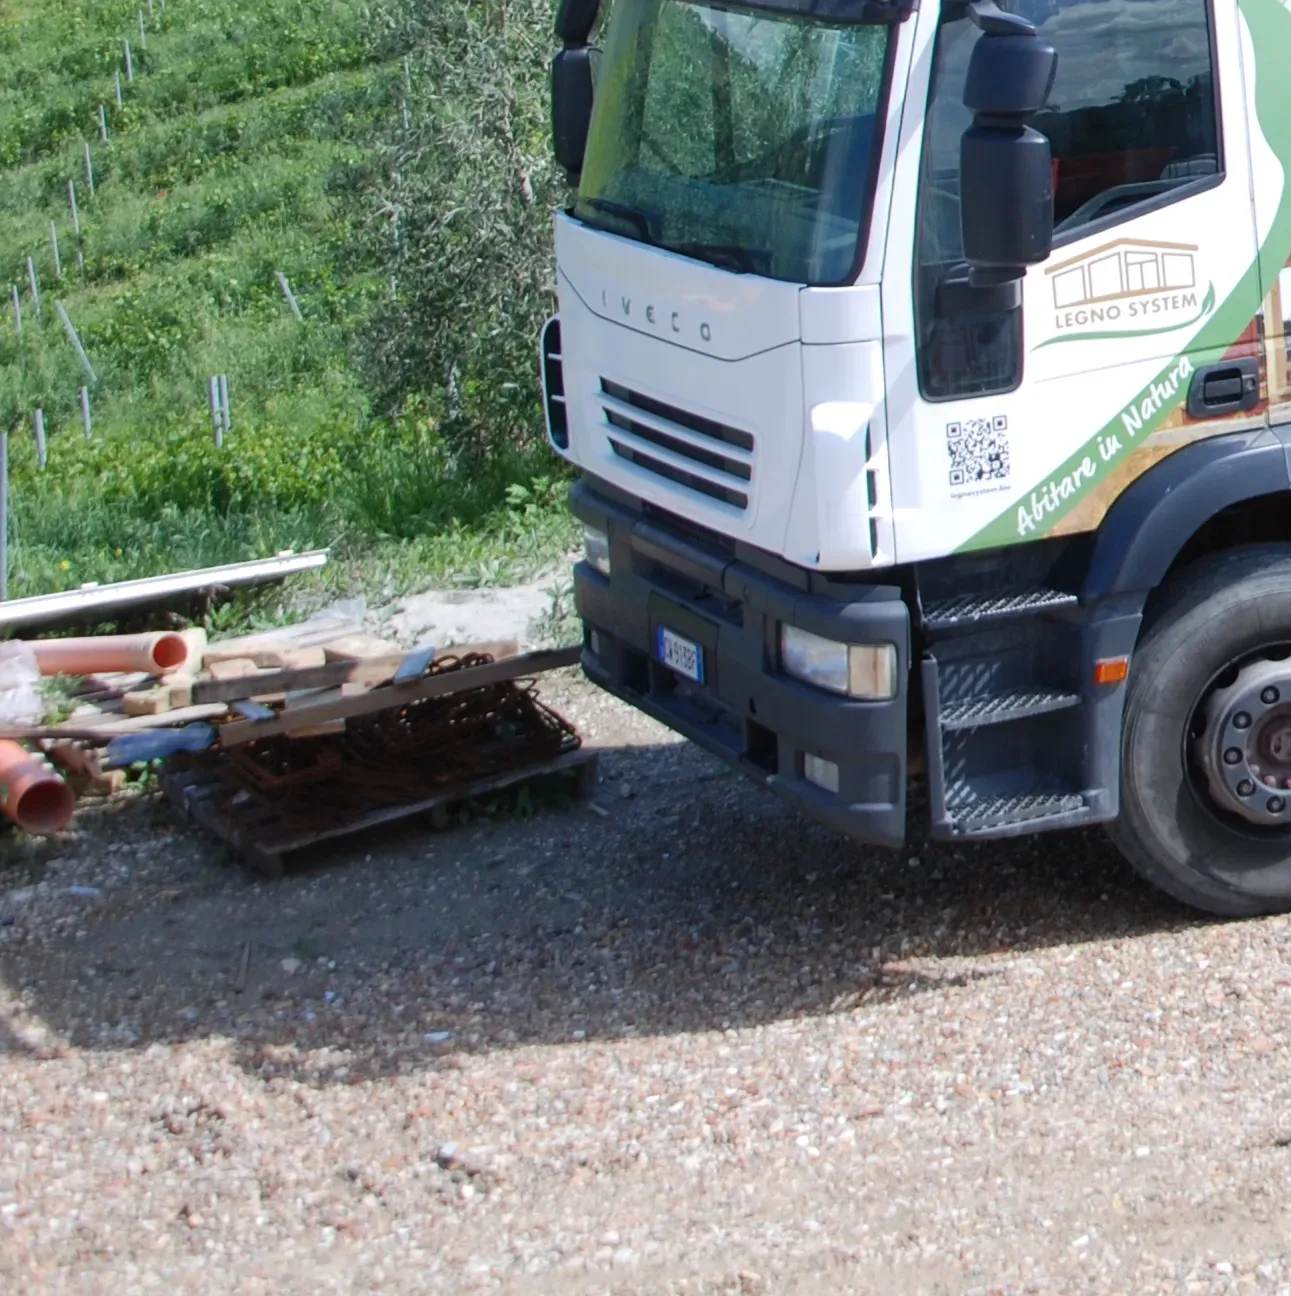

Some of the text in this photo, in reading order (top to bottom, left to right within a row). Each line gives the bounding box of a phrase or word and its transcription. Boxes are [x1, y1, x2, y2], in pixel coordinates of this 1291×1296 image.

[602, 288, 711, 342] IVECO
[1055, 292, 1198, 329] LEGNO SYSTEM
[1017, 356, 1194, 536] Abitare in Natura
